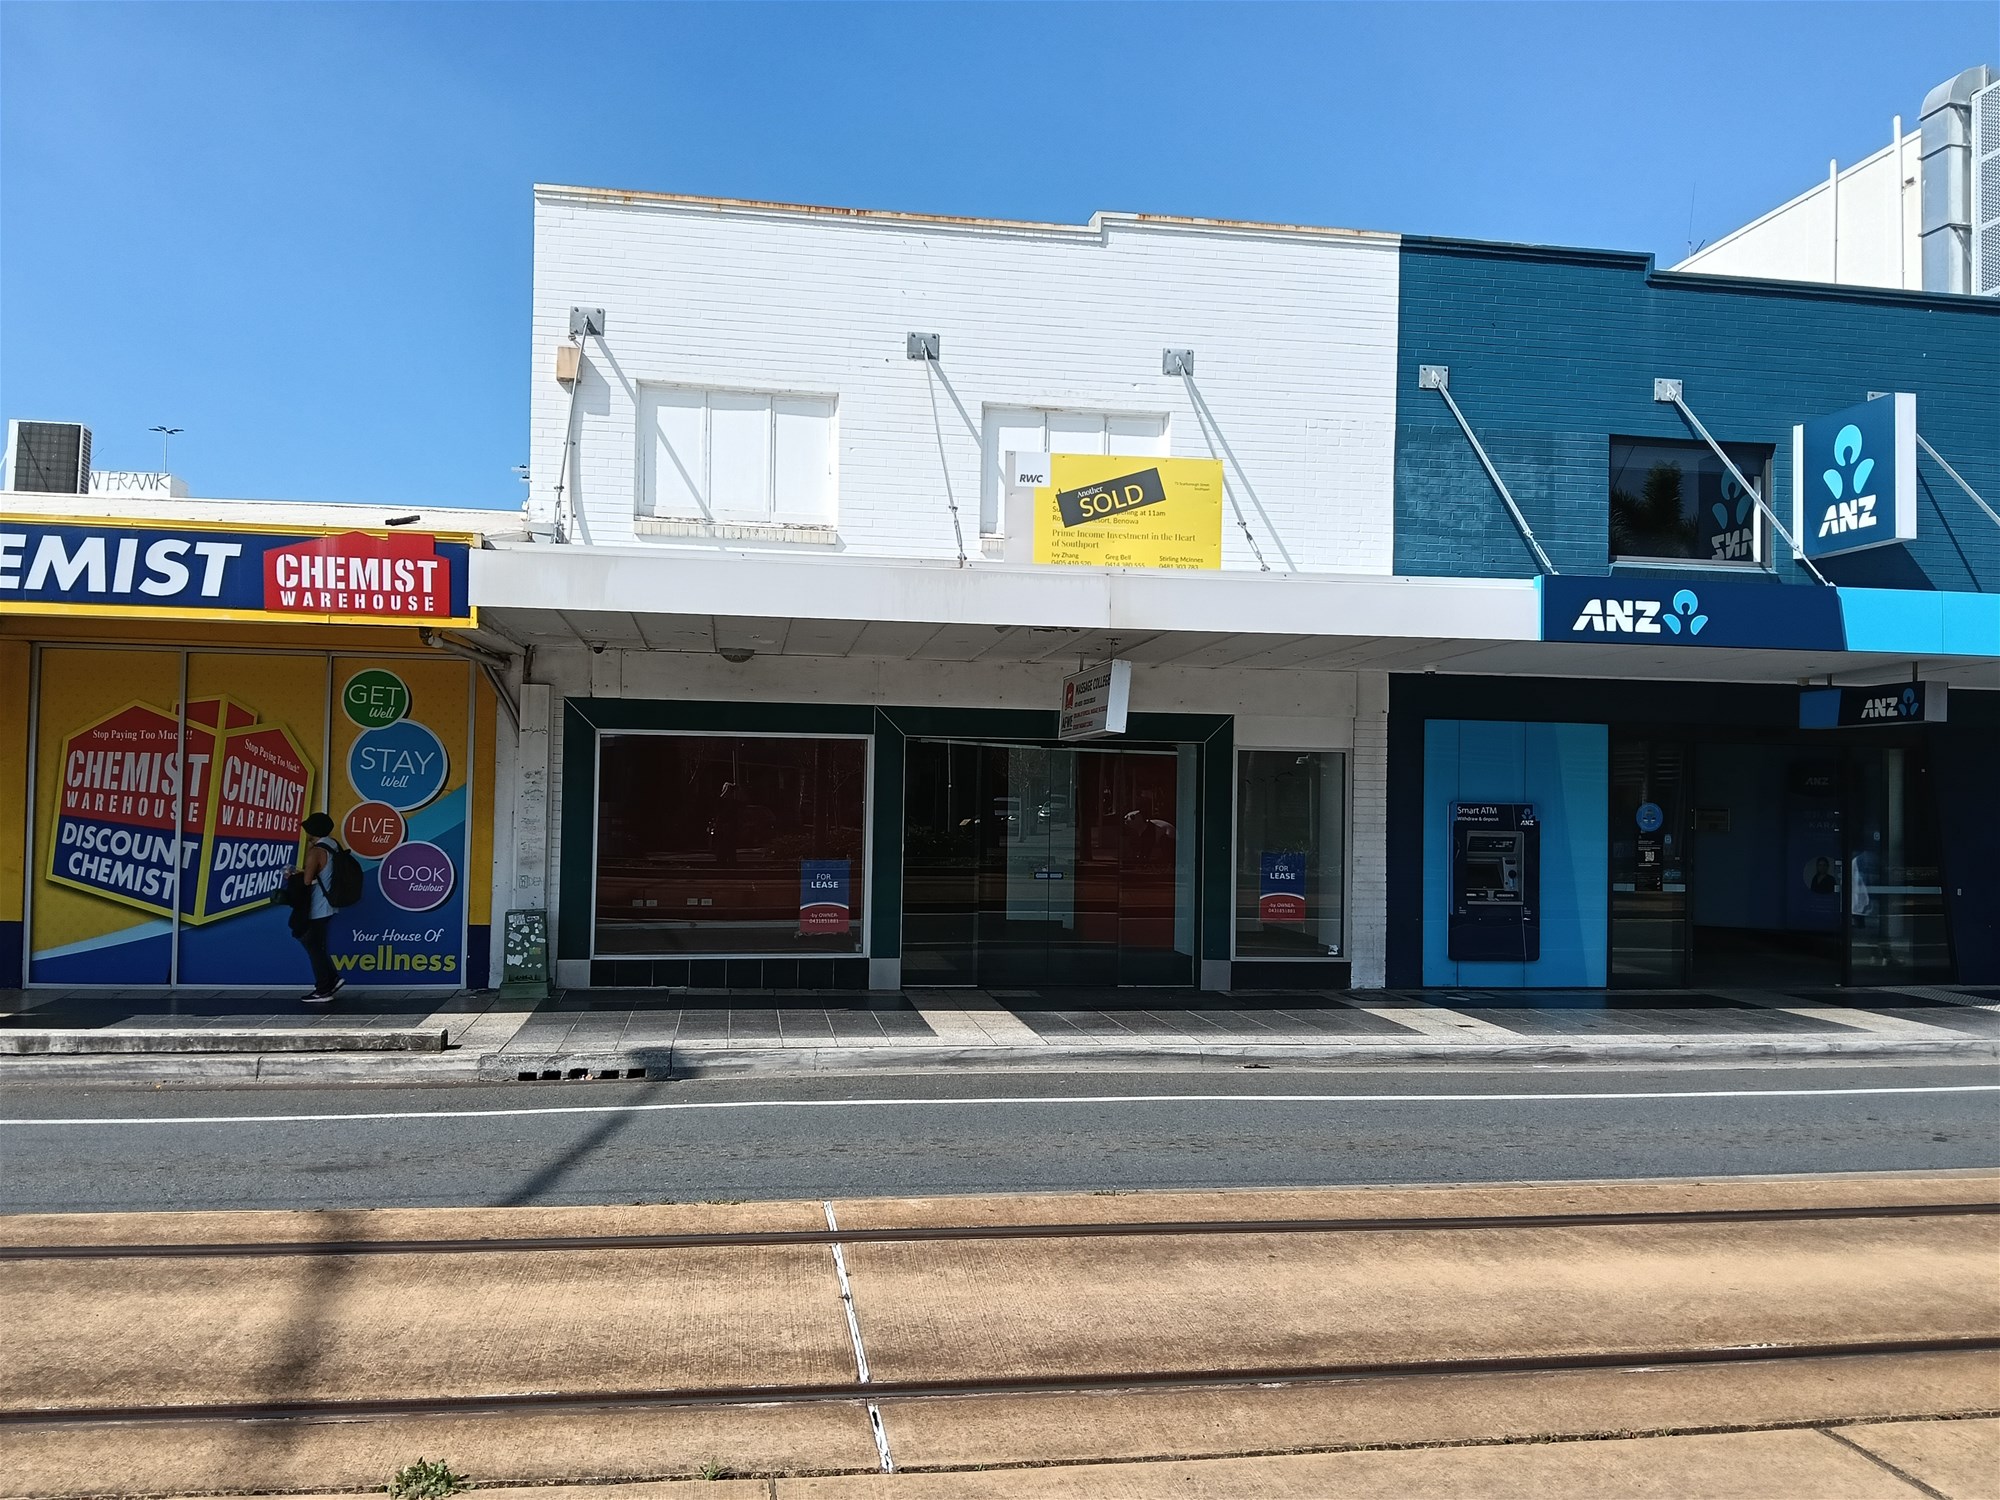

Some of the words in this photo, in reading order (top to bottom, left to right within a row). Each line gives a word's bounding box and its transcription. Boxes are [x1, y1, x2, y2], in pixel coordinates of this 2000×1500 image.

[106, 471, 170, 491] FRANK
[1019, 474, 1043, 484] RWC
[1077, 486, 1103, 498] Another
[1080, 484, 1144, 518] SOLD
[1113, 517, 1139, 525] Benowa
[1818, 494, 1877, 538] ANZ
[1052, 529, 1075, 538] Prime
[1077, 530, 1105, 538] Income
[1107, 530, 1150, 540] Investment
[1151, 532, 1159, 540] in
[1161, 532, 1173, 541] the
[1175, 533, 1196, 542] Heart
[1061, 540, 1099, 550] Southport
[0, 533, 243, 597] EMIST
[1105, 553, 1119, 561] Greg
[275, 553, 438, 594] CHEMIST
[280, 590, 434, 612] WAREHOUSE
[1572, 598, 1661, 634] ANZ
[348, 684, 402, 706] GET
[368, 707, 395, 719] Well
[1860, 696, 1898, 719] ANZ
[92, 729, 109, 741] Stop
[111, 729, 138, 742] Paying
[139, 730, 155, 740] Too
[244, 738, 259, 756] Stop
[259, 745, 277, 765] Paying
[277, 754, 286, 767] Too
[360, 747, 435, 775] STAY
[66, 749, 210, 797] CHEMIST
[380, 775, 409, 789] Well
[222, 755, 305, 815] CHEMIST
[66, 790, 199, 823] WAREHOUSE
[1457, 806, 1479, 815] Smart
[1480, 806, 1498, 815] ATM
[222, 804, 298, 833] WAREHOUSE
[350, 816, 395, 835] LIVE
[61, 822, 199, 869] DISCOUNT
[371, 834, 390, 845] Well
[214, 842, 294, 872] DISCOUNT
[68, 851, 176, 900] CHEMIST
[388, 865, 446, 883] LOOK
[810, 881, 839, 889] LEASE
[1269, 872, 1296, 880] LEASE
[220, 870, 285, 904] CHEMIST
[408, 881, 444, 892] Fabulous
[352, 928, 379, 942] Your
[381, 928, 422, 942] House
[424, 928, 444, 942] Of
[330, 944, 457, 972] wellness
